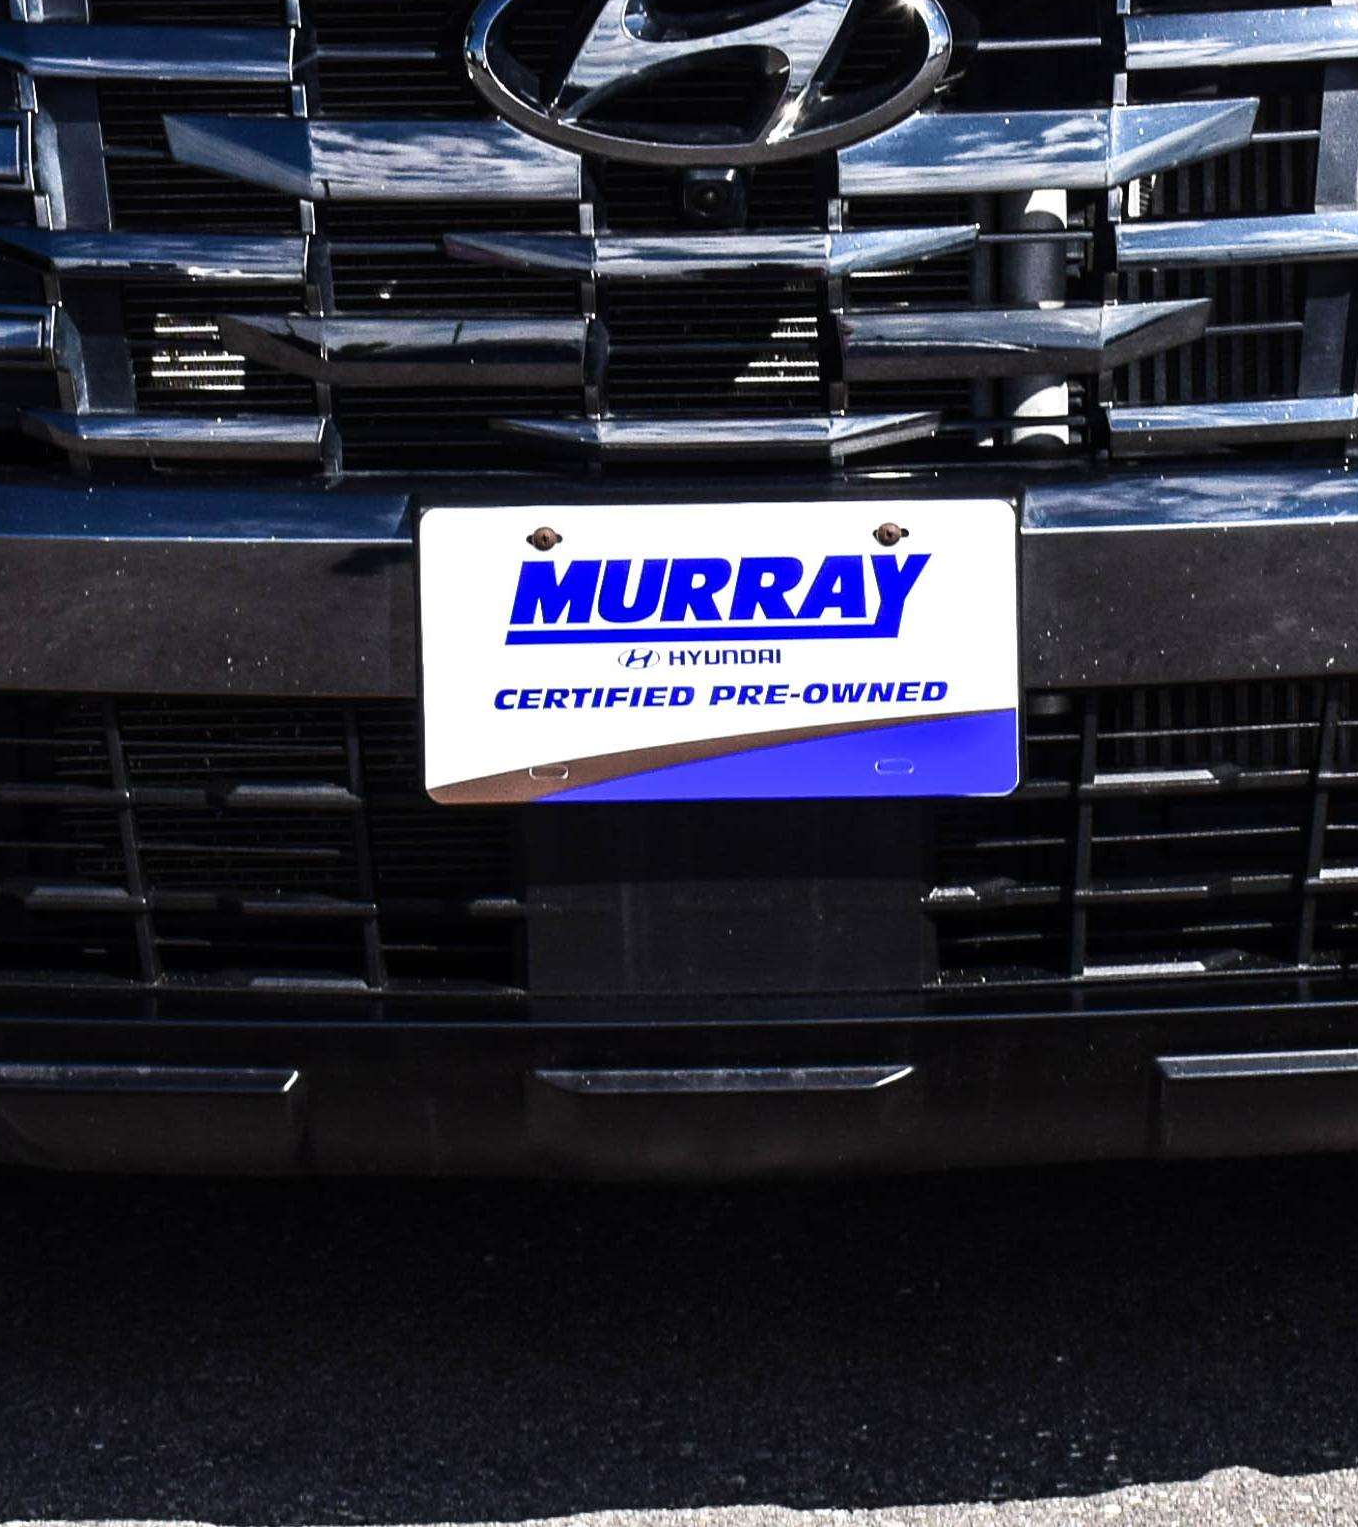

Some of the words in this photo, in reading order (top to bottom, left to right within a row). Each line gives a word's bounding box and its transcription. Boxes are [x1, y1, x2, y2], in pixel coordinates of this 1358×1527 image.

[507, 553, 932, 639] MURRAY
[669, 648, 781, 666] HYUNDAI
[493, 686, 695, 711] CERTIFIED
[709, 681, 948, 706] PRE-OWNED
